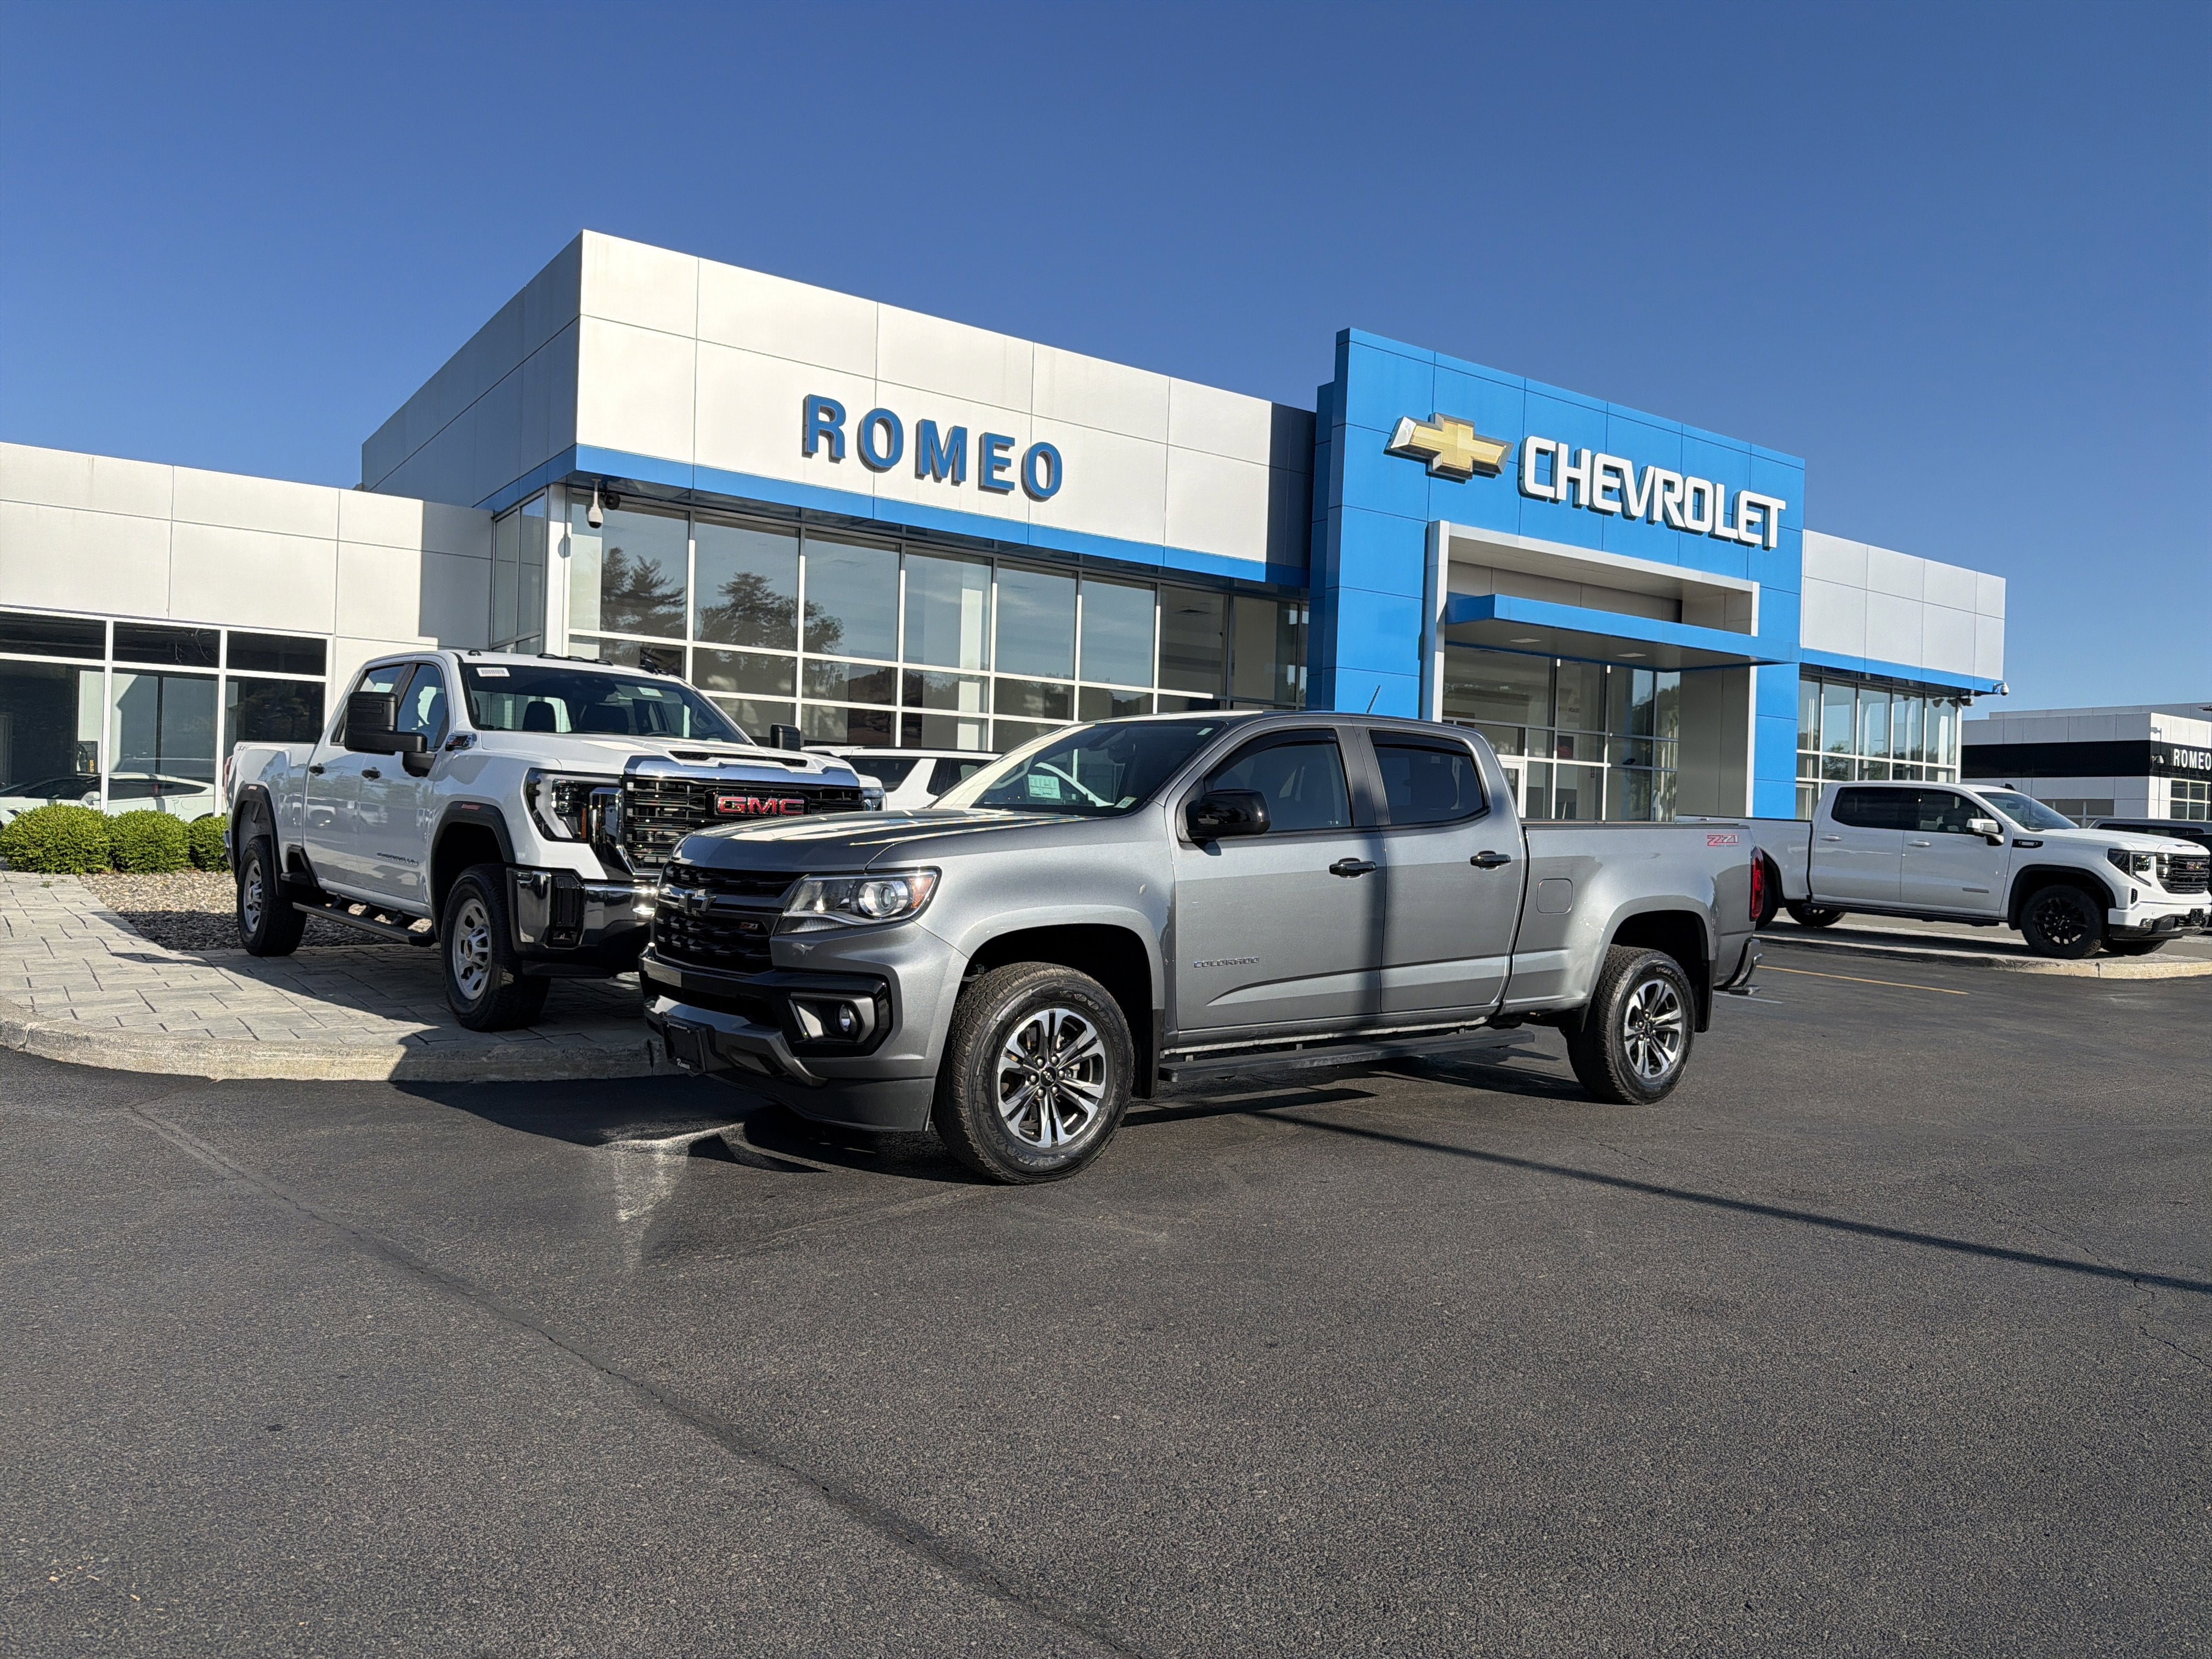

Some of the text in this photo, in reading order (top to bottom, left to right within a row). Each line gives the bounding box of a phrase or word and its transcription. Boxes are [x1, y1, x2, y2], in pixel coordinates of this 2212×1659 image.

[803, 394, 1062, 501] ROMEO
[1520, 436, 1786, 550] CHEVROLET
[2174, 748, 2211, 771] ROMEO
[718, 796, 804, 815] GMC
[1707, 834, 1739, 846] Z71
[1194, 956, 1260, 968] COLORADO
